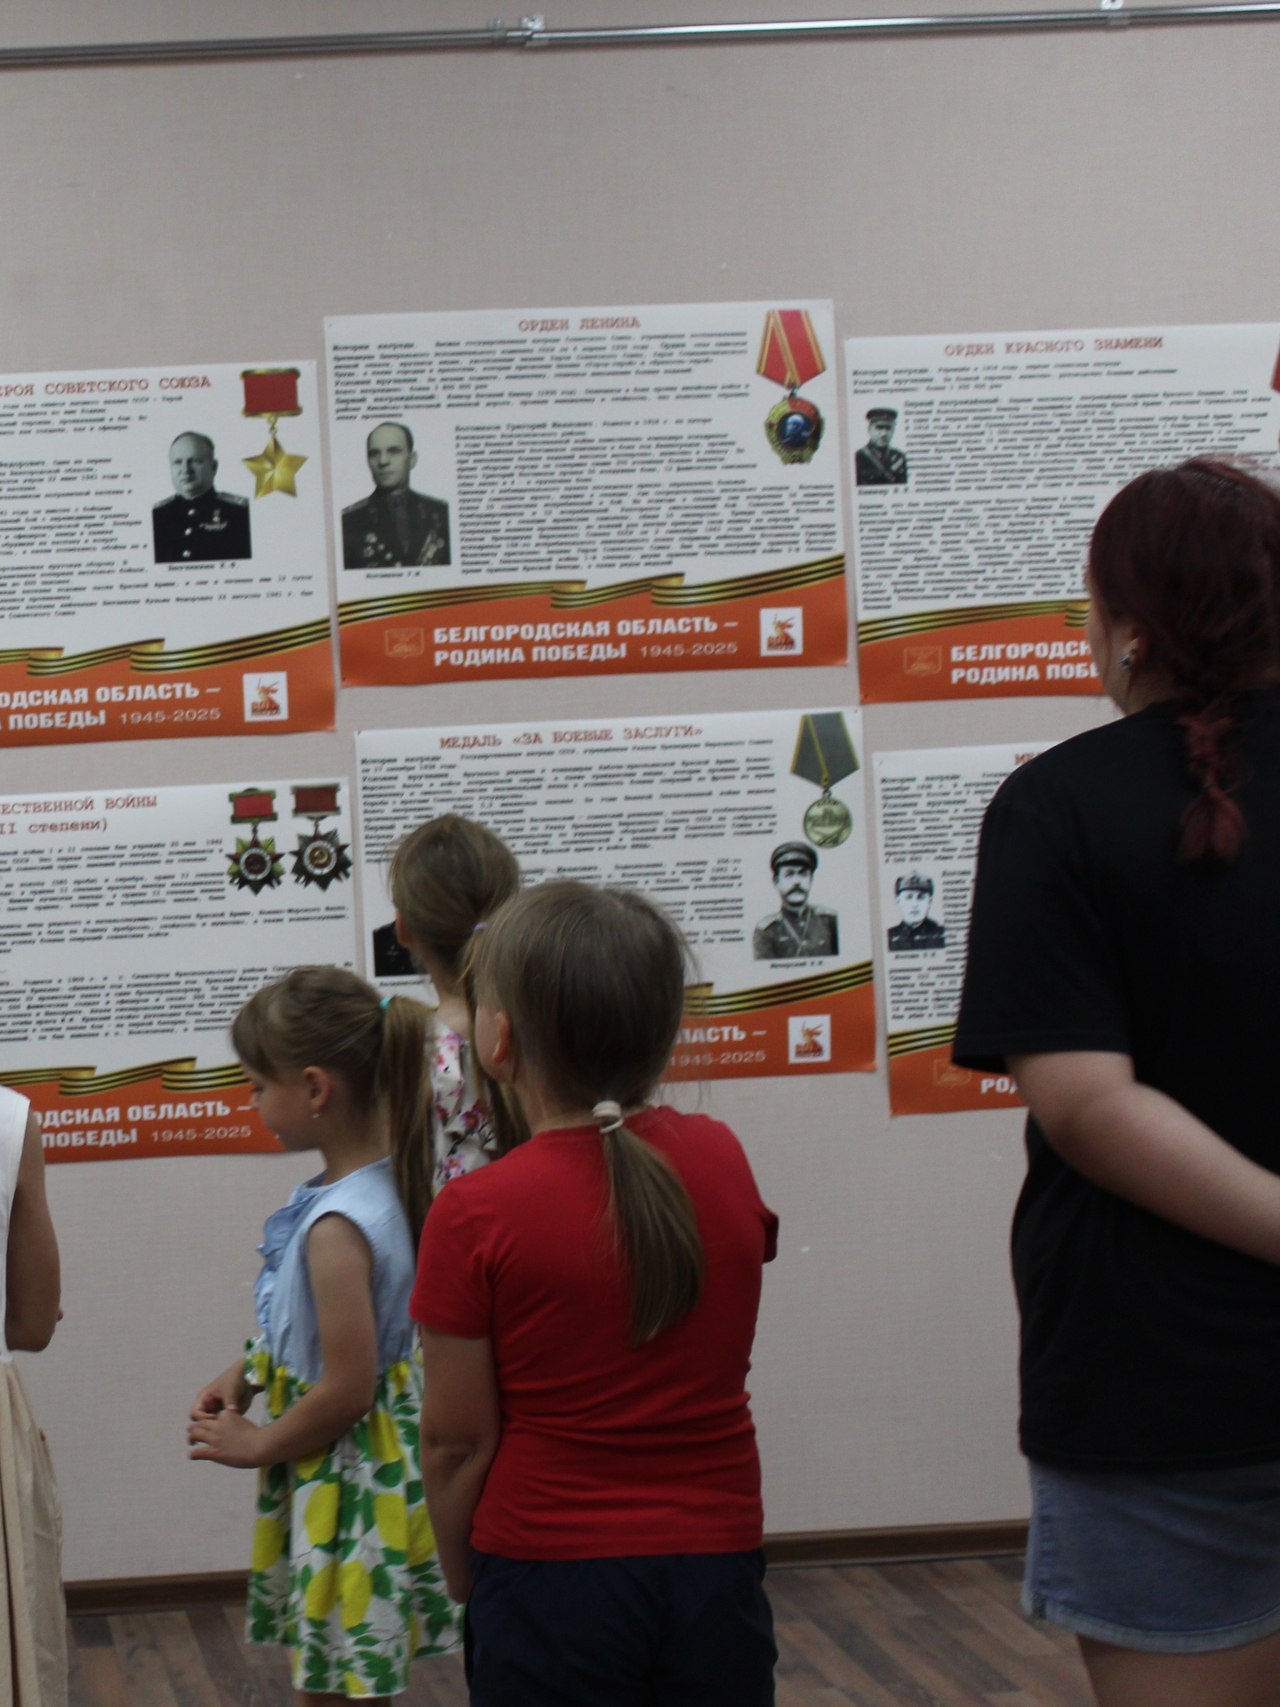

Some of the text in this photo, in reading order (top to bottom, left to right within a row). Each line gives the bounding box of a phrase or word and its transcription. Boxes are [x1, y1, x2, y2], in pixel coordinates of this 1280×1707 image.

[518, 317, 640, 332] ОРДЕН ЛЕНИНА
[944, 337, 1163, 356] ОРДЕН КРАСНОГО ЗНАМЕНИ
[45, 379, 149, 395] СОВЕТСКОГО
[159, 376, 211, 389] СОЮЗА
[434, 621, 610, 643] БЕЛГОРОДСКАЯ
[617, 617, 717, 636] ОБЛАСТЬ
[435, 642, 737, 667] РОДИНА ПОБЕДЫ 1945-2025
[951, 665, 1040, 684] РОДИНА
[96, 683, 199, 703] ОБЛАСТЬ
[9, 710, 106, 729] ПОБЕДЫ
[120, 708, 221, 724] 1945-2025
[440, 725, 702, 749] МЕДАЛЬ «ЗА БОЕВЫЕ ЗАСЛУГИ»
[105, 795, 157, 809] ВОЙНЫ
[28, 819, 107, 833] степени)
[675, 1026, 746, 1044] ЛАСТЬ
[128, 1101, 230, 1121] ОБЛАСТЬ
[41, 1125, 252, 1148] ПОБЕДЫ 1945-2025
